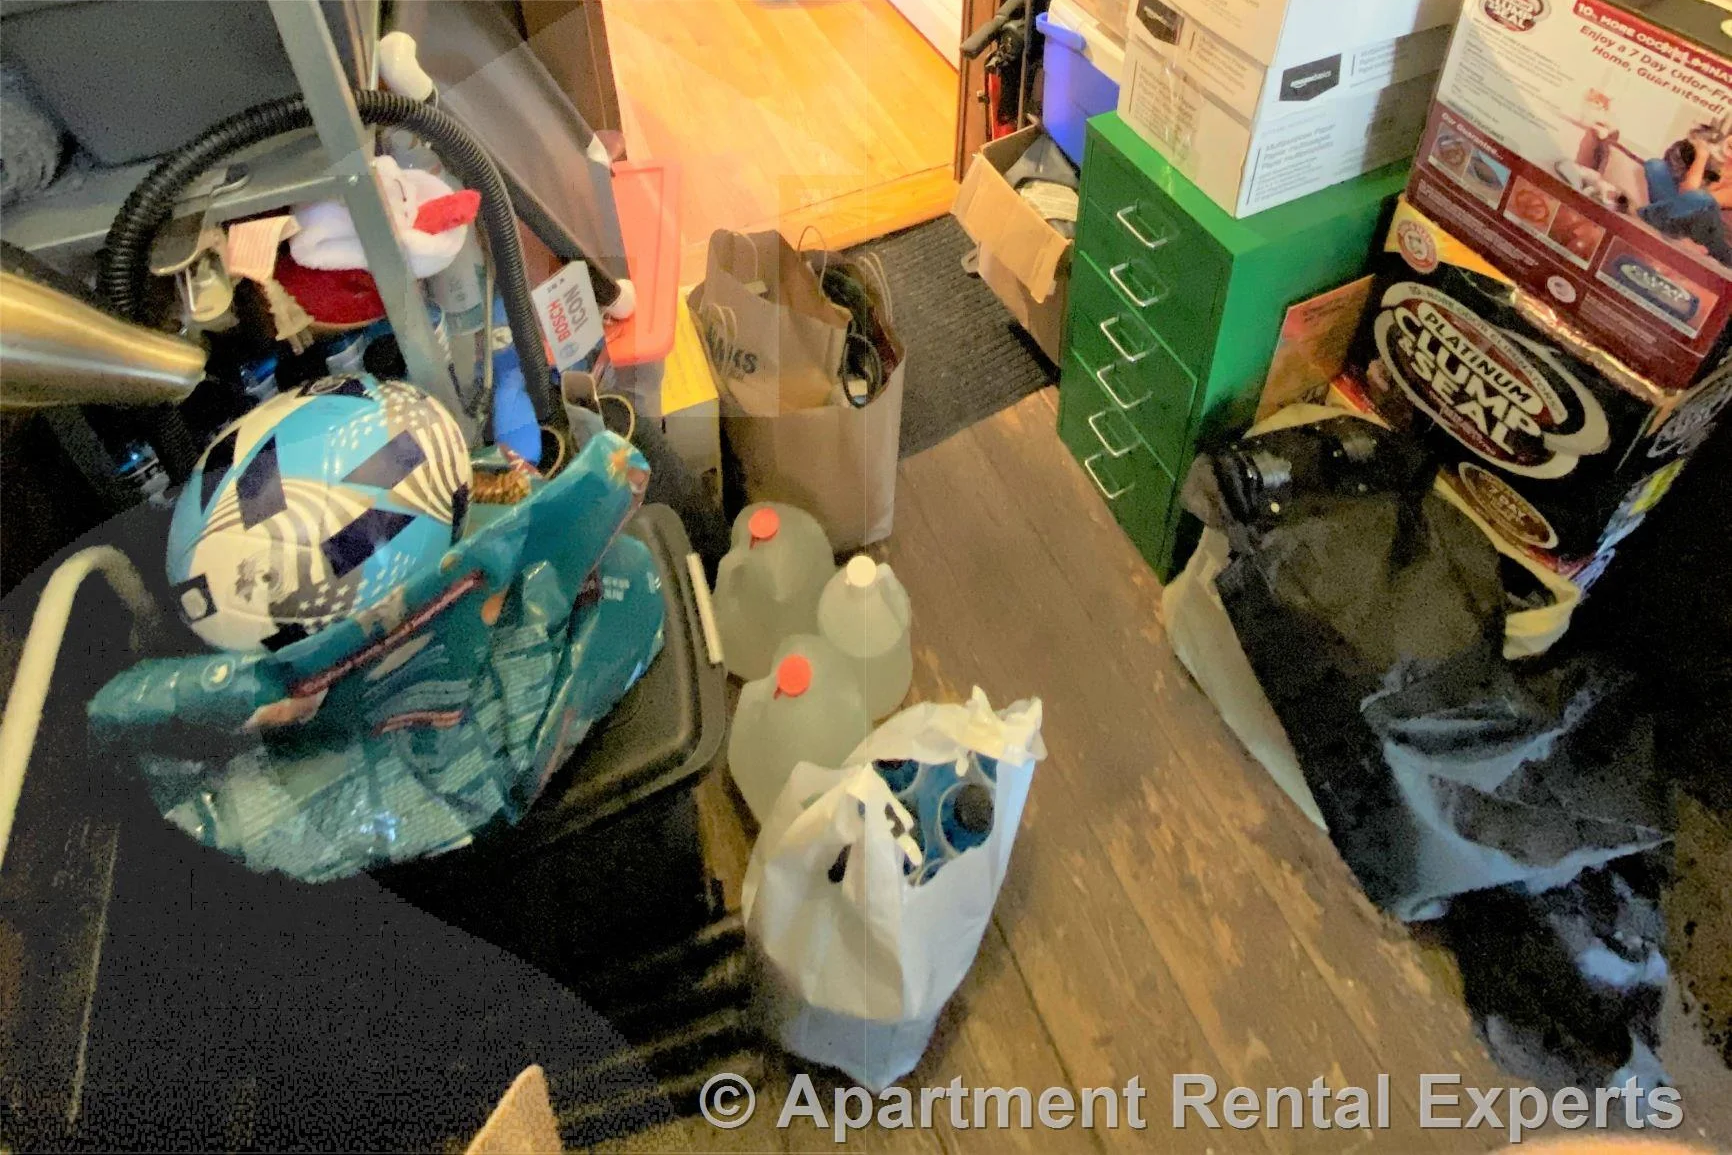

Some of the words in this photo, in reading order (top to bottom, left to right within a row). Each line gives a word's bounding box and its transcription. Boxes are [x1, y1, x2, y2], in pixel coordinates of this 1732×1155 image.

[1579, 24, 1616, 48] Enjoy
[1617, 43, 1626, 53] a
[1630, 47, 1640, 58] 7
[1640, 53, 1667, 73] Day
[1600, 15, 1636, 37] MORE
[1591, 44, 1631, 73] Home,
[547, 298, 572, 343] BOSCH
[563, 283, 589, 333] ICON
[1394, 305, 1542, 438] CLUMP
[1424, 311, 1532, 404] PLATINUM
[1411, 351, 1515, 456] SEAL
